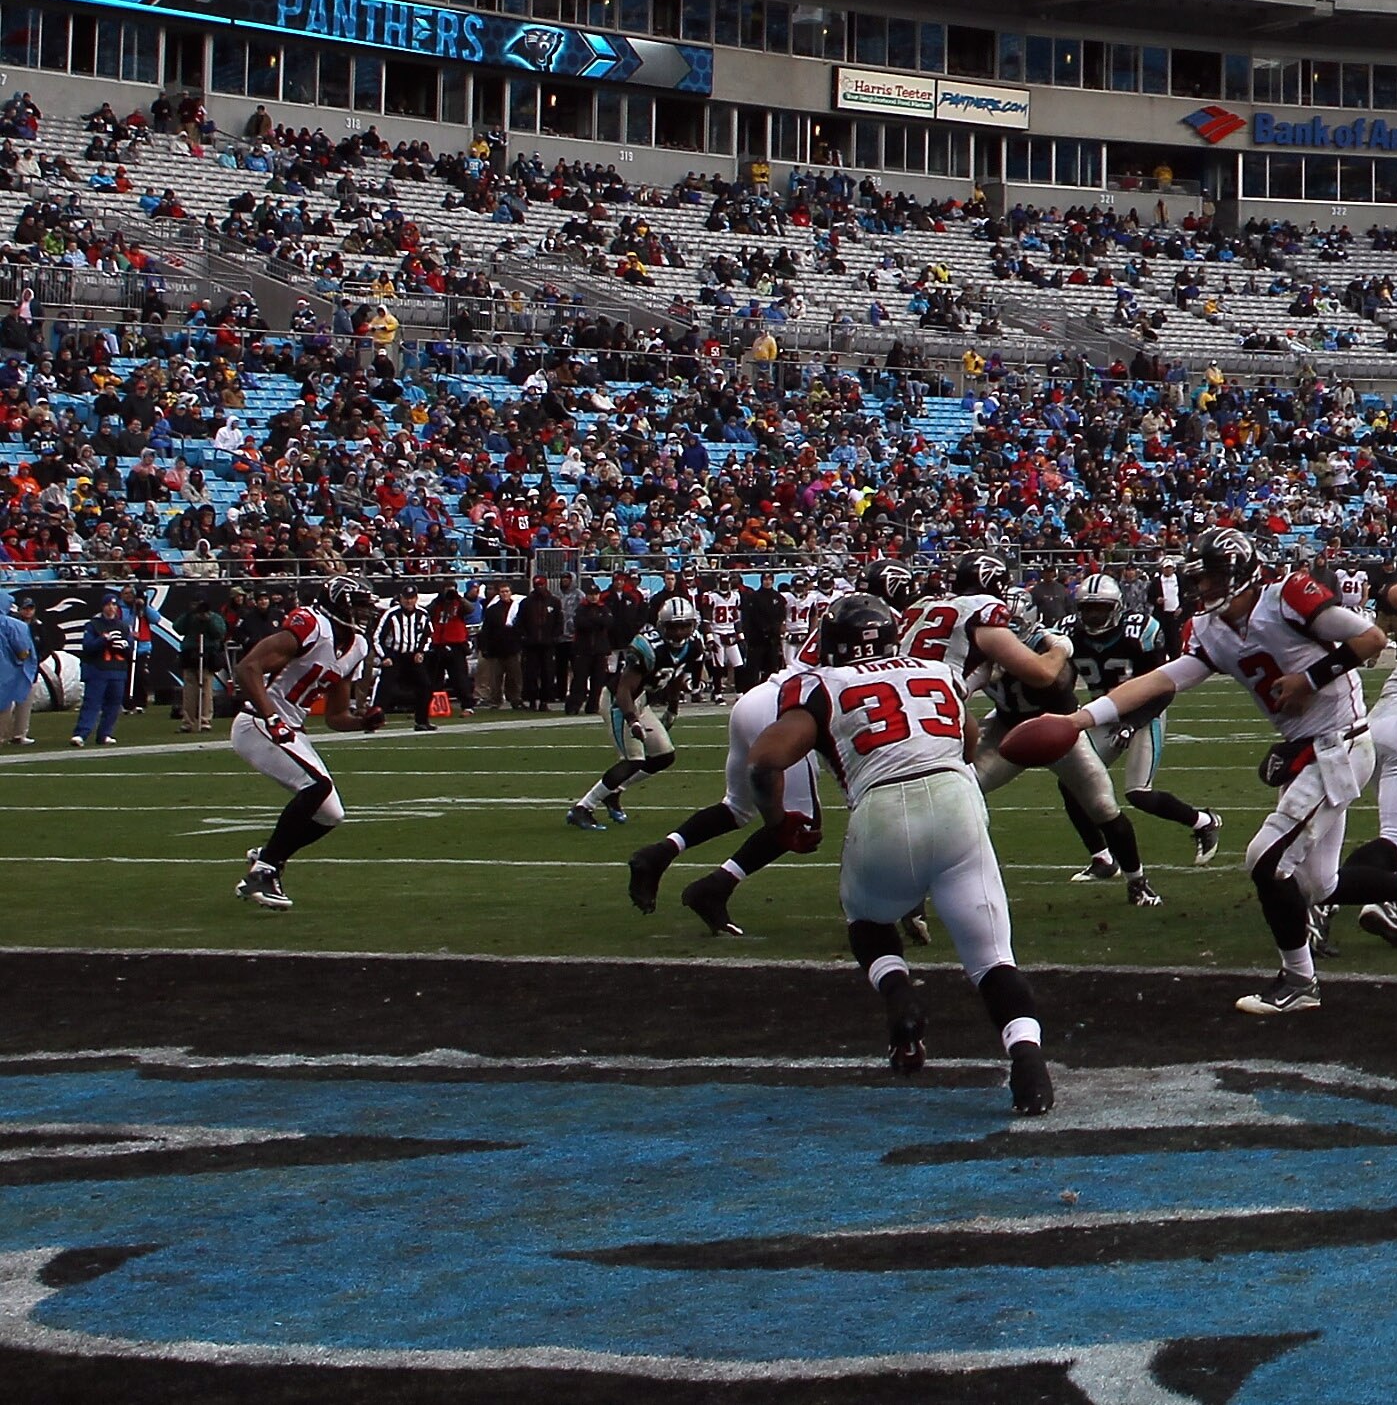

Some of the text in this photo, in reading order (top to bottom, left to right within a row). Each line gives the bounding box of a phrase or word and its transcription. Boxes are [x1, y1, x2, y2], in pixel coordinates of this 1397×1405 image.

[854, 80, 933, 101] Harris Teeter
[346, 118, 361, 130] 318
[1254, 113, 1331, 145] Bank
[1334, 118, 1366, 148] of
[620, 150, 634, 162] 319
[1100, 195, 1114, 204] 321
[1331, 207, 1347, 216] 322
[1342, 581, 1358, 594] 61
[715, 604, 738, 623] 83
[901, 606, 960, 661] 72
[853, 644, 874, 657] 33
[1238, 651, 1284, 715] 2
[432, 694, 449, 713] 30
[839, 678, 962, 756] 33
